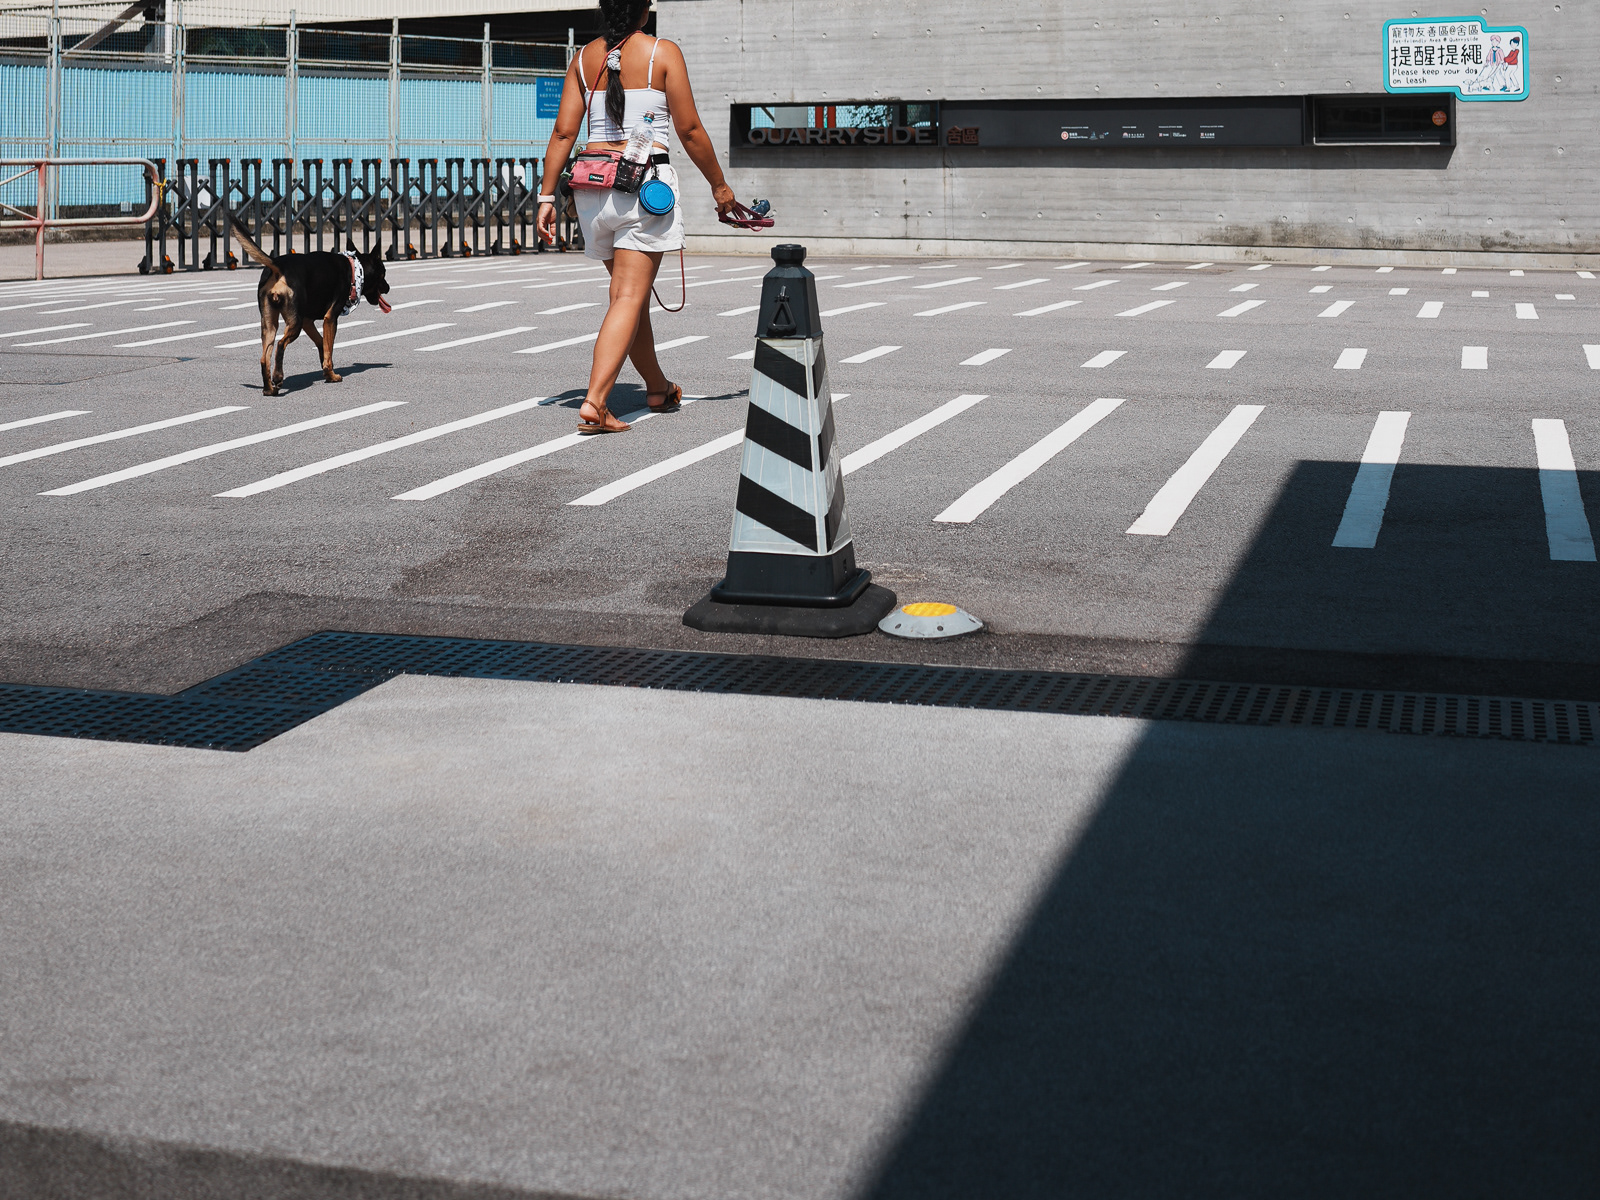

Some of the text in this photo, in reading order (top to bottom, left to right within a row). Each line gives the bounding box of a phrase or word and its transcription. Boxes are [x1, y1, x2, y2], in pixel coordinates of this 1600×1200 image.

[1391, 44, 1483, 67] 提醒提繩
[1392, 67, 1478, 76] Please keep your dog
[747, 126, 934, 145] QUARRYSIDE
[946, 125, 980, 145] 舍區
